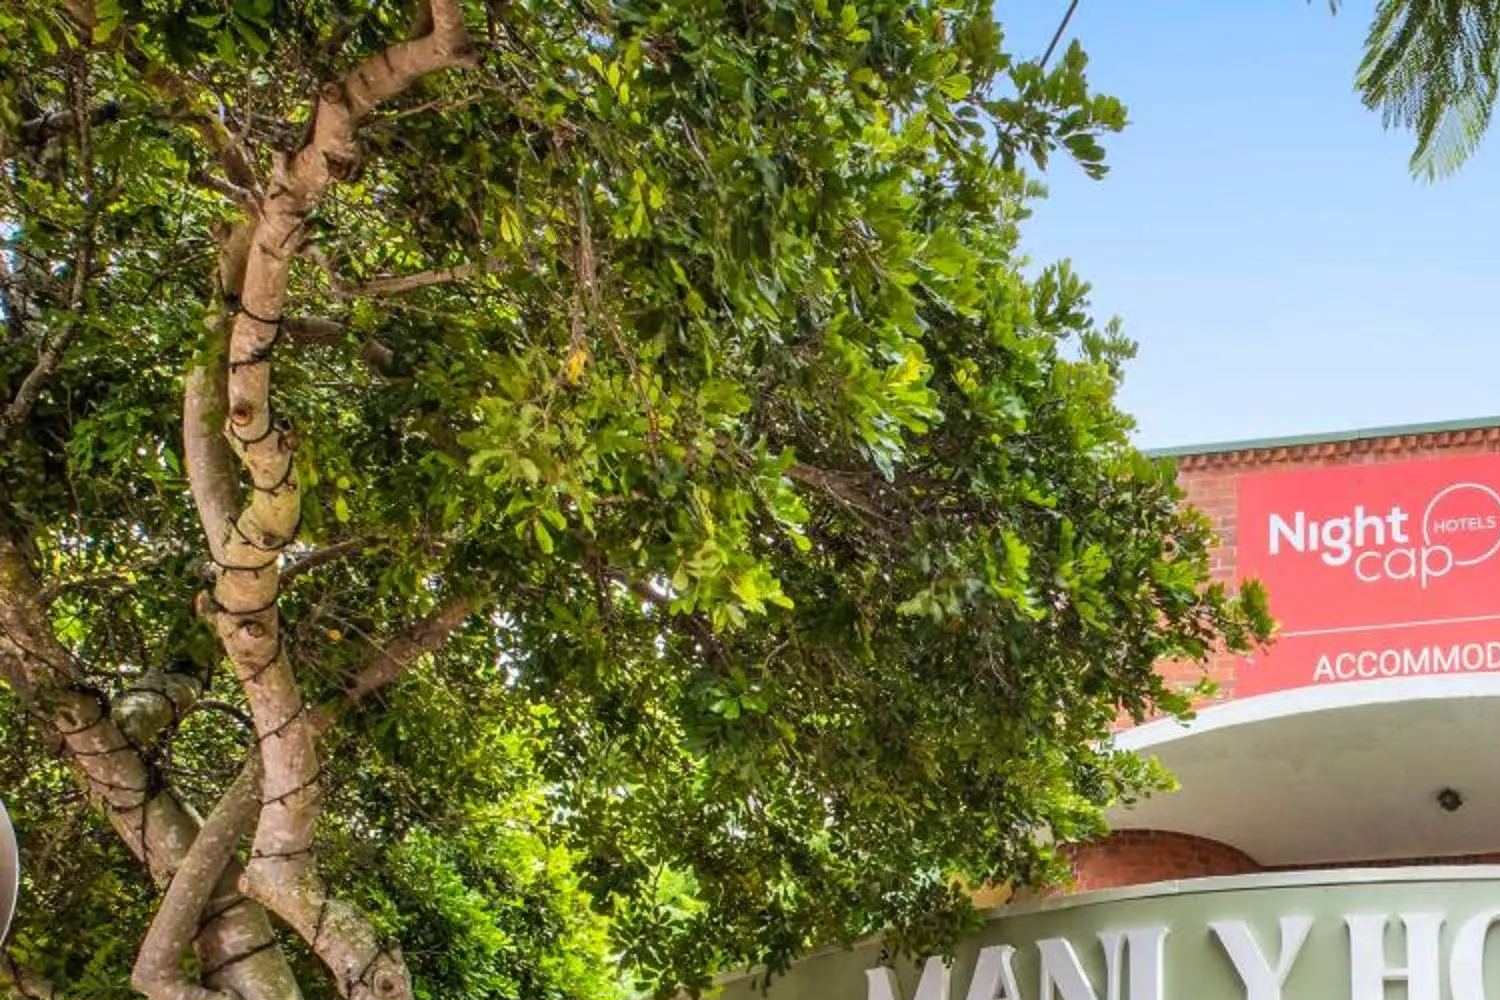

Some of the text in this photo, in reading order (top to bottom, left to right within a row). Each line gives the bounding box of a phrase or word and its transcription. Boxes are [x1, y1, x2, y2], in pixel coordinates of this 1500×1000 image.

[1268, 505, 1409, 567] Night
[1432, 514, 1498, 535] HOTELS
[1354, 543, 1454, 589] cap
